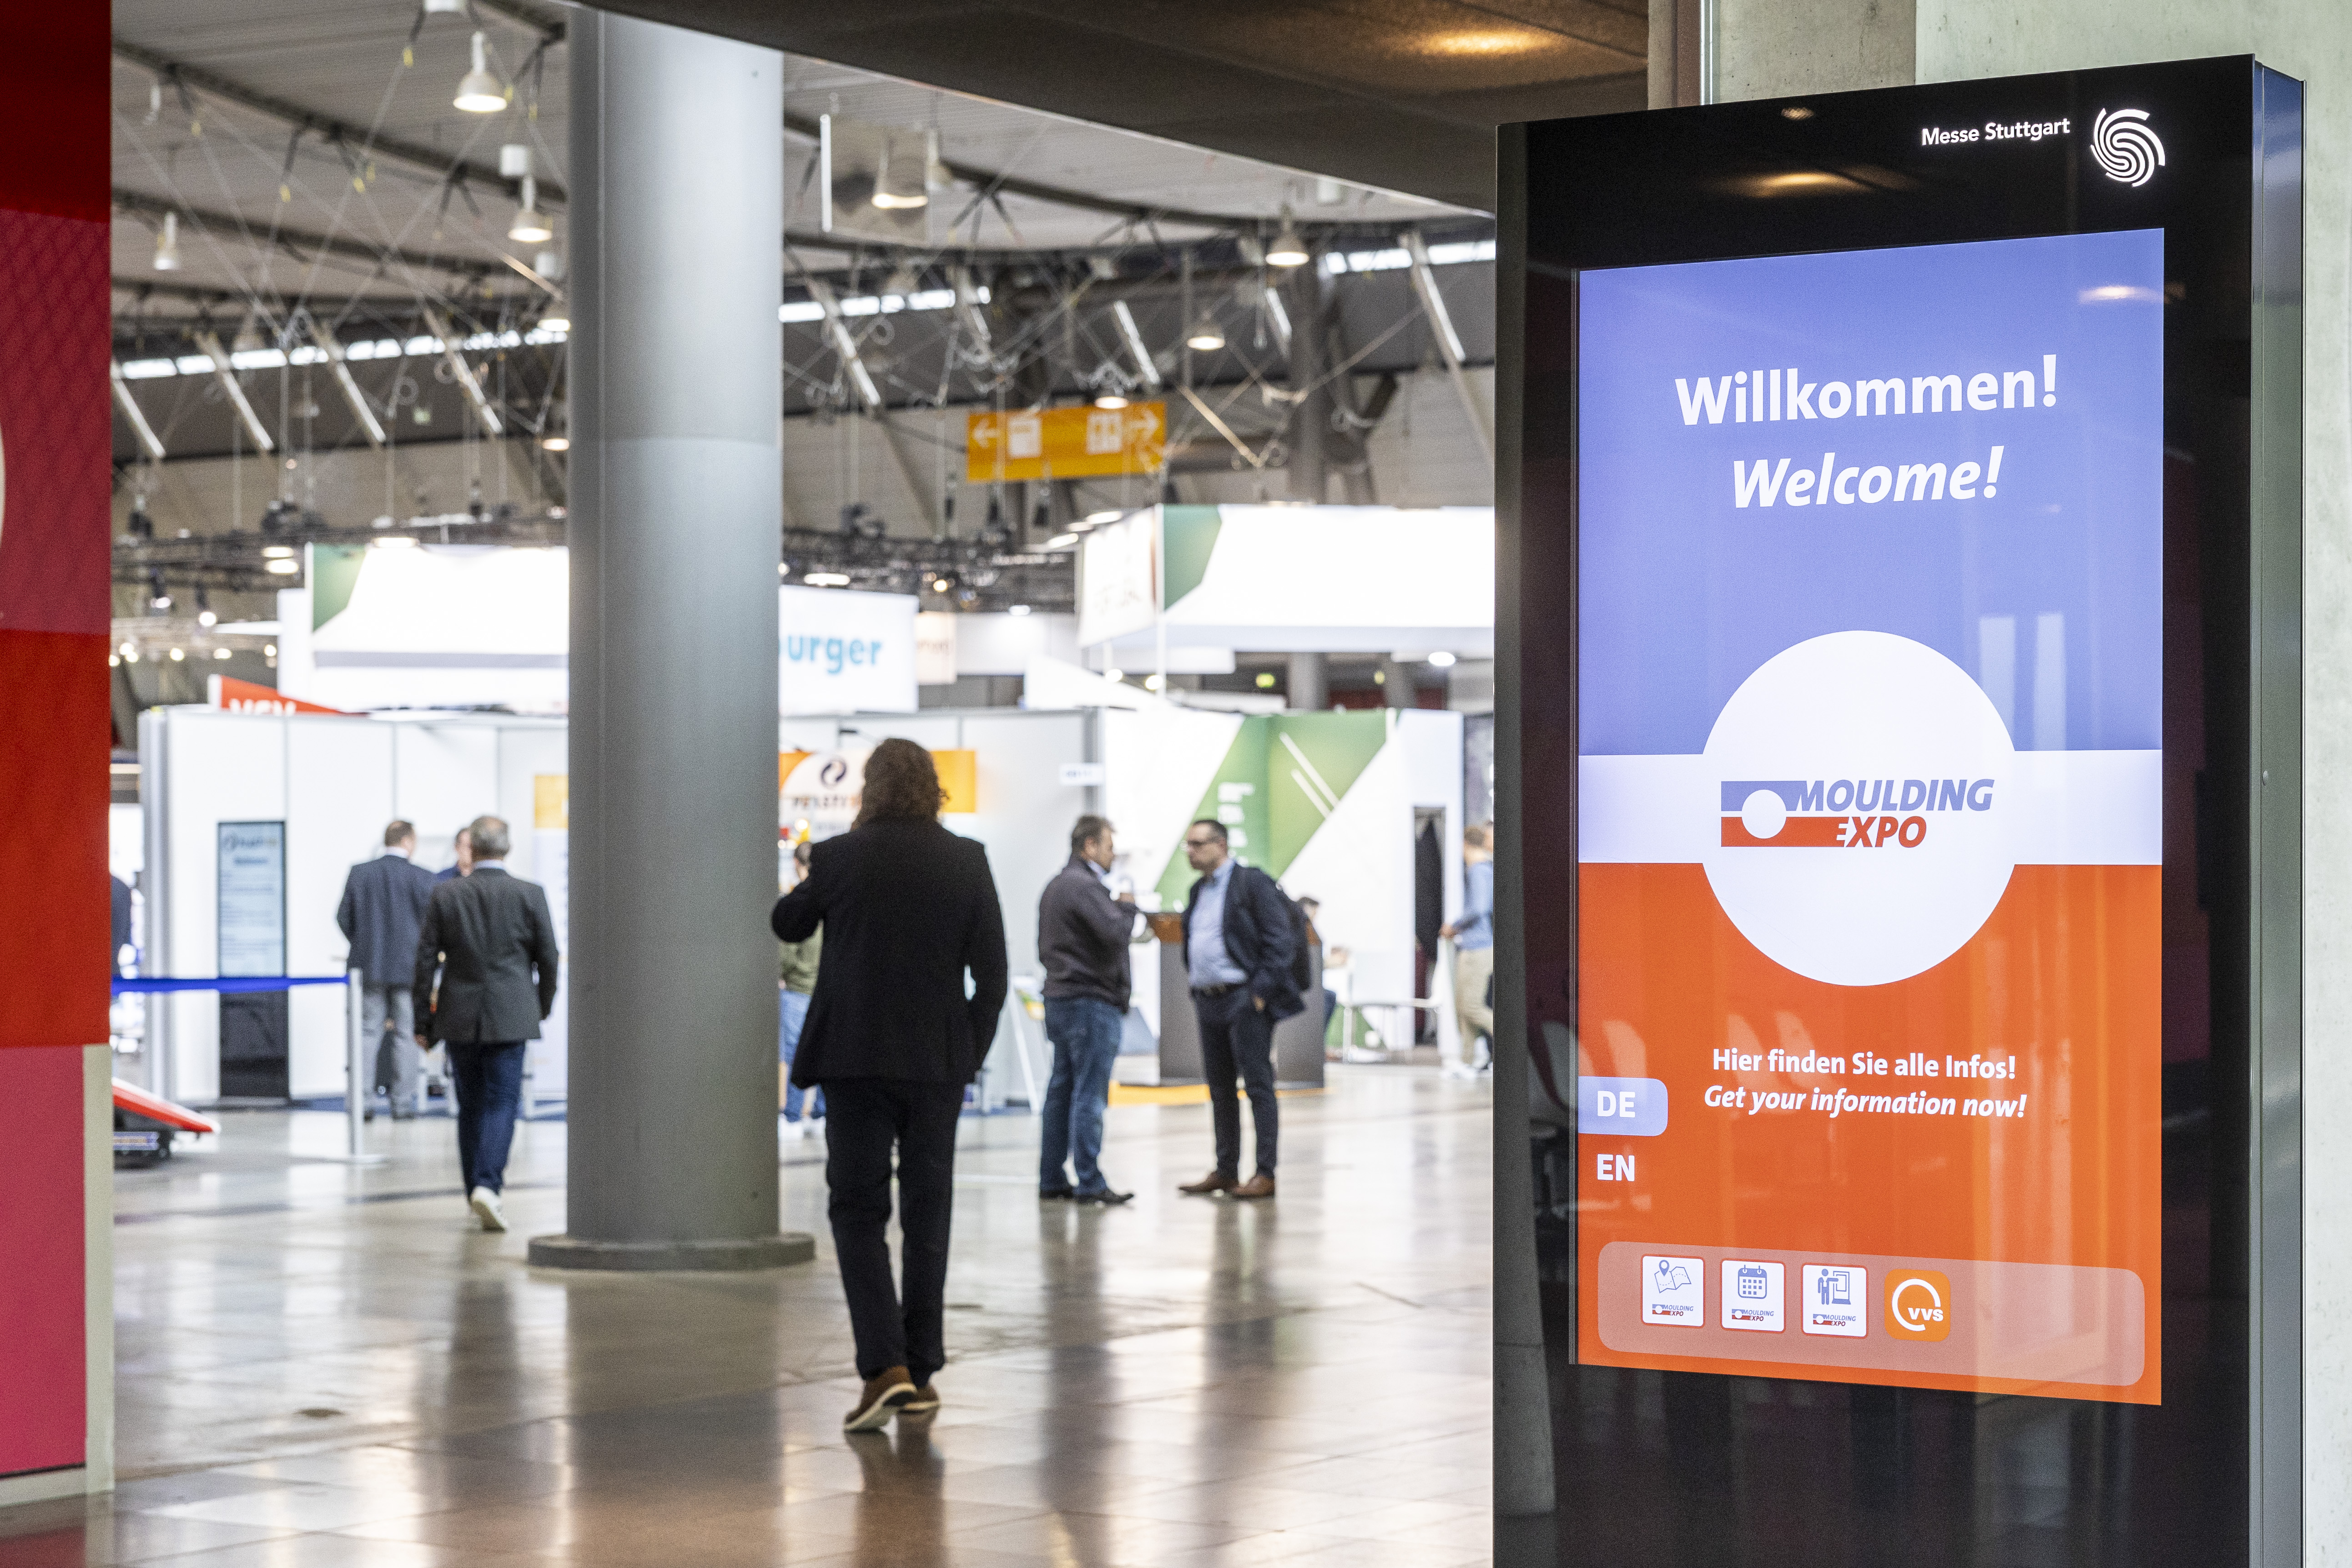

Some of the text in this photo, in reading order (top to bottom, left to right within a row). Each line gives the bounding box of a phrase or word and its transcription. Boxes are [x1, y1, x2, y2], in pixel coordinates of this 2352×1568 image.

[1922, 118, 2070, 146] Messe Stuttgart
[1675, 354, 2057, 425] Willkommen!
[1733, 445, 2004, 508] Welcome!
[779, 634, 883, 675] urger
[1796, 779, 1995, 812] MOULDING
[1836, 816, 1927, 848] EXPO
[1713, 1047, 2015, 1079] Hier finden Sie alle Infos!
[1597, 1090, 1636, 1118] DE
[1704, 1085, 2028, 1119] Get your information now!
[1597, 1154, 1635, 1182] EN
[1908, 1307, 1944, 1322] VVS
